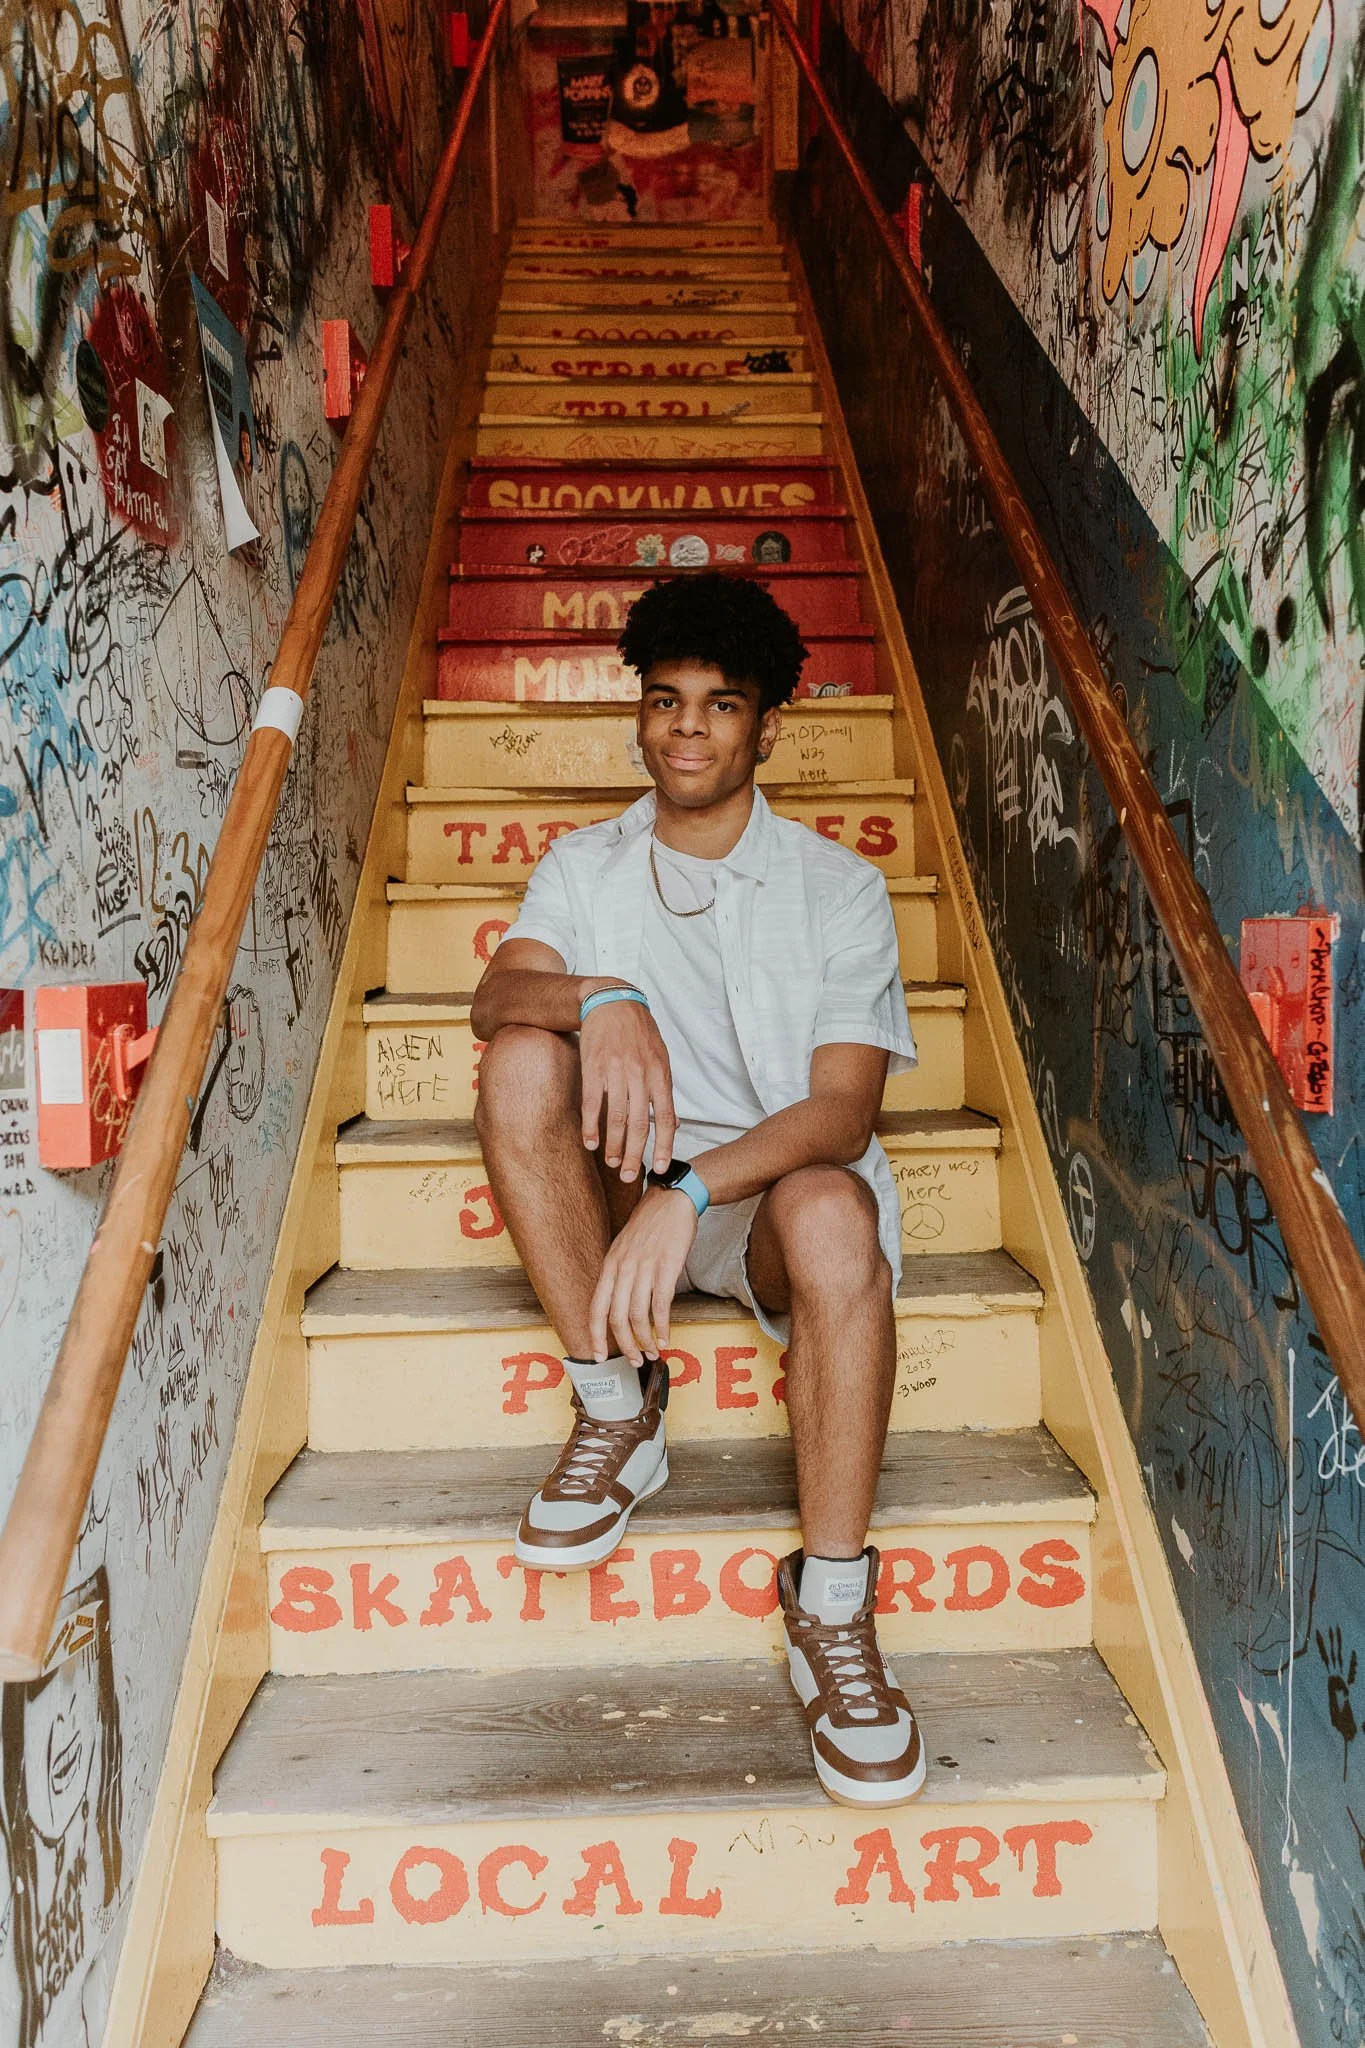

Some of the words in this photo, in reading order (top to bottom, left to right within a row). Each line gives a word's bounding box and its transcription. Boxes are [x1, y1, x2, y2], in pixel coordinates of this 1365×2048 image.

[489, 479, 816, 509] SHOCKWAVES
[39, 933, 97, 968] KENDRA
[270, 1538, 1086, 1632] SKATEBORDS
[311, 1837, 722, 1927] LOCAL
[833, 1819, 1093, 1914] ART
